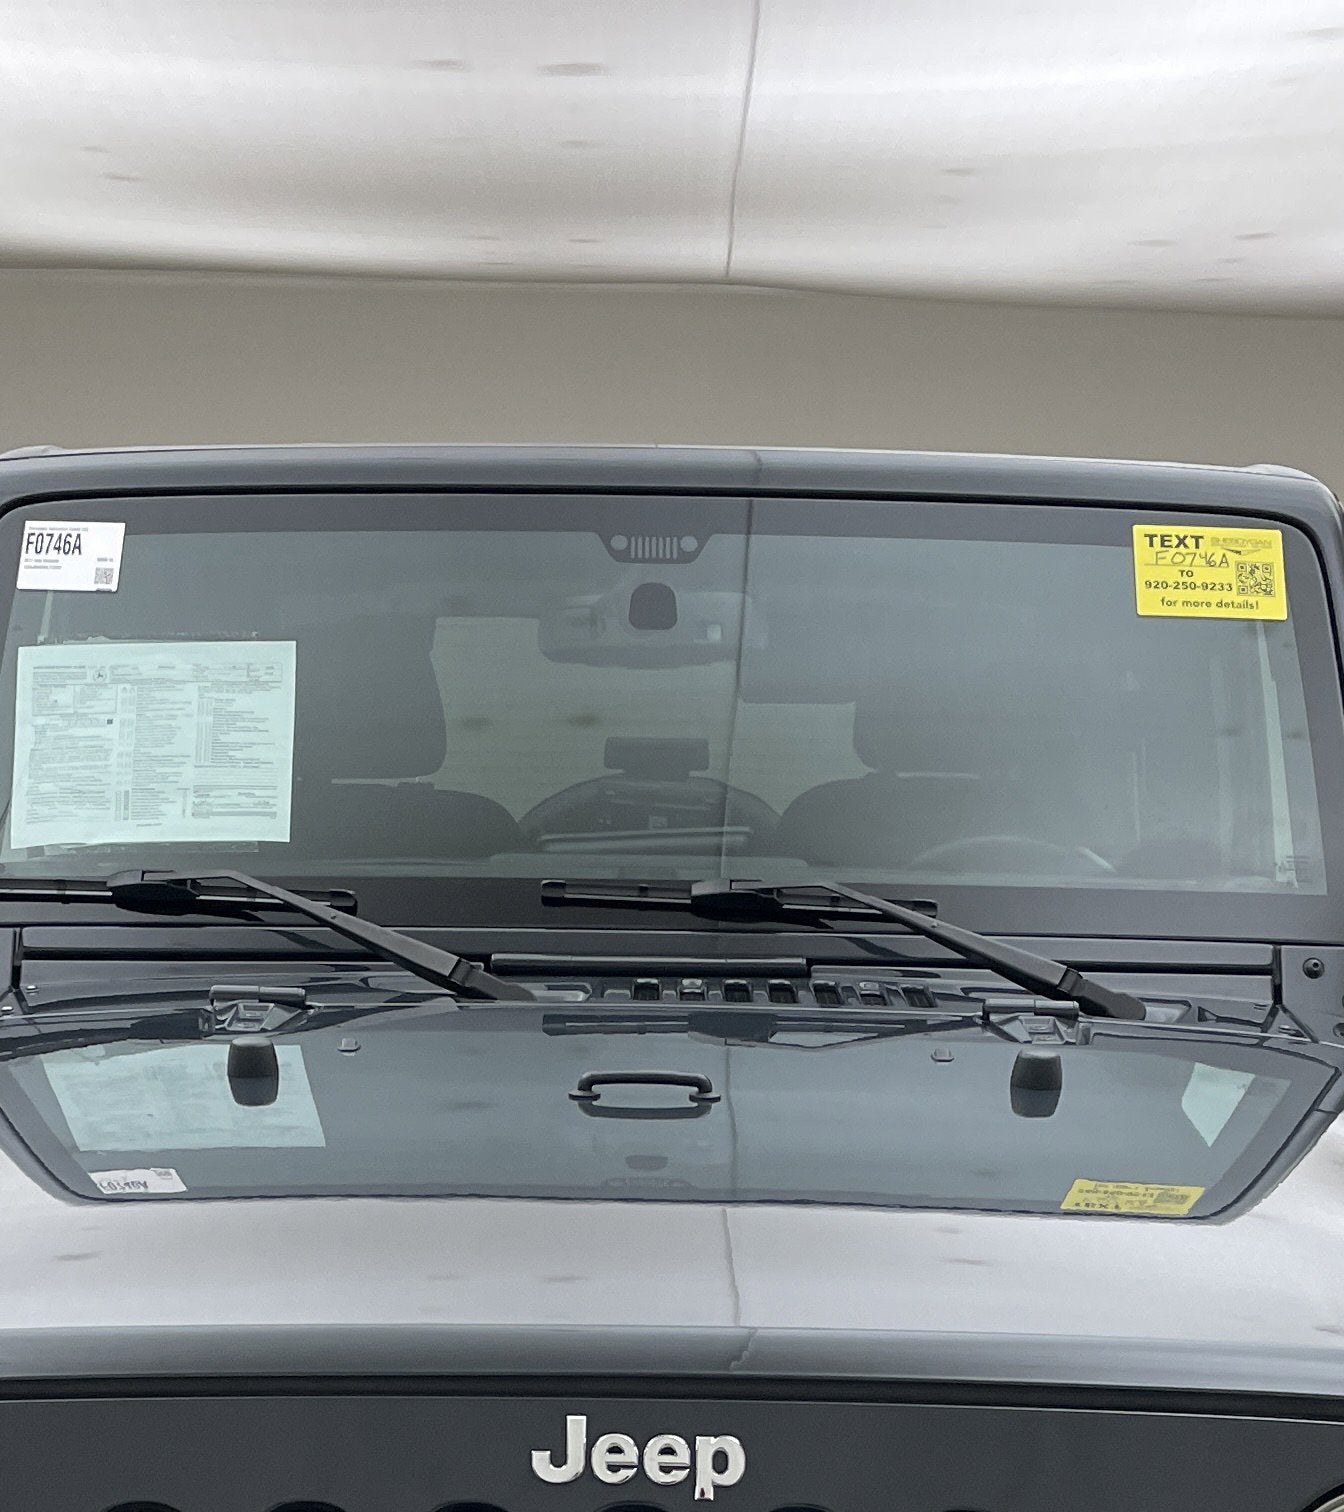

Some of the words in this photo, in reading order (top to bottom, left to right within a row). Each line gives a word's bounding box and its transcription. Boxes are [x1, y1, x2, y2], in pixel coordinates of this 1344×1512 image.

[25, 532, 82, 556] F0746A
[1144, 533, 1204, 549] TEXT
[1179, 569, 1194, 578] TO
[1144, 581, 1233, 592] 920-250-9233
[1161, 596, 1177, 607] for
[1182, 600, 1212, 609] more
[1216, 598, 1259, 610] details!
[531, 1415, 746, 1501] Jeep
